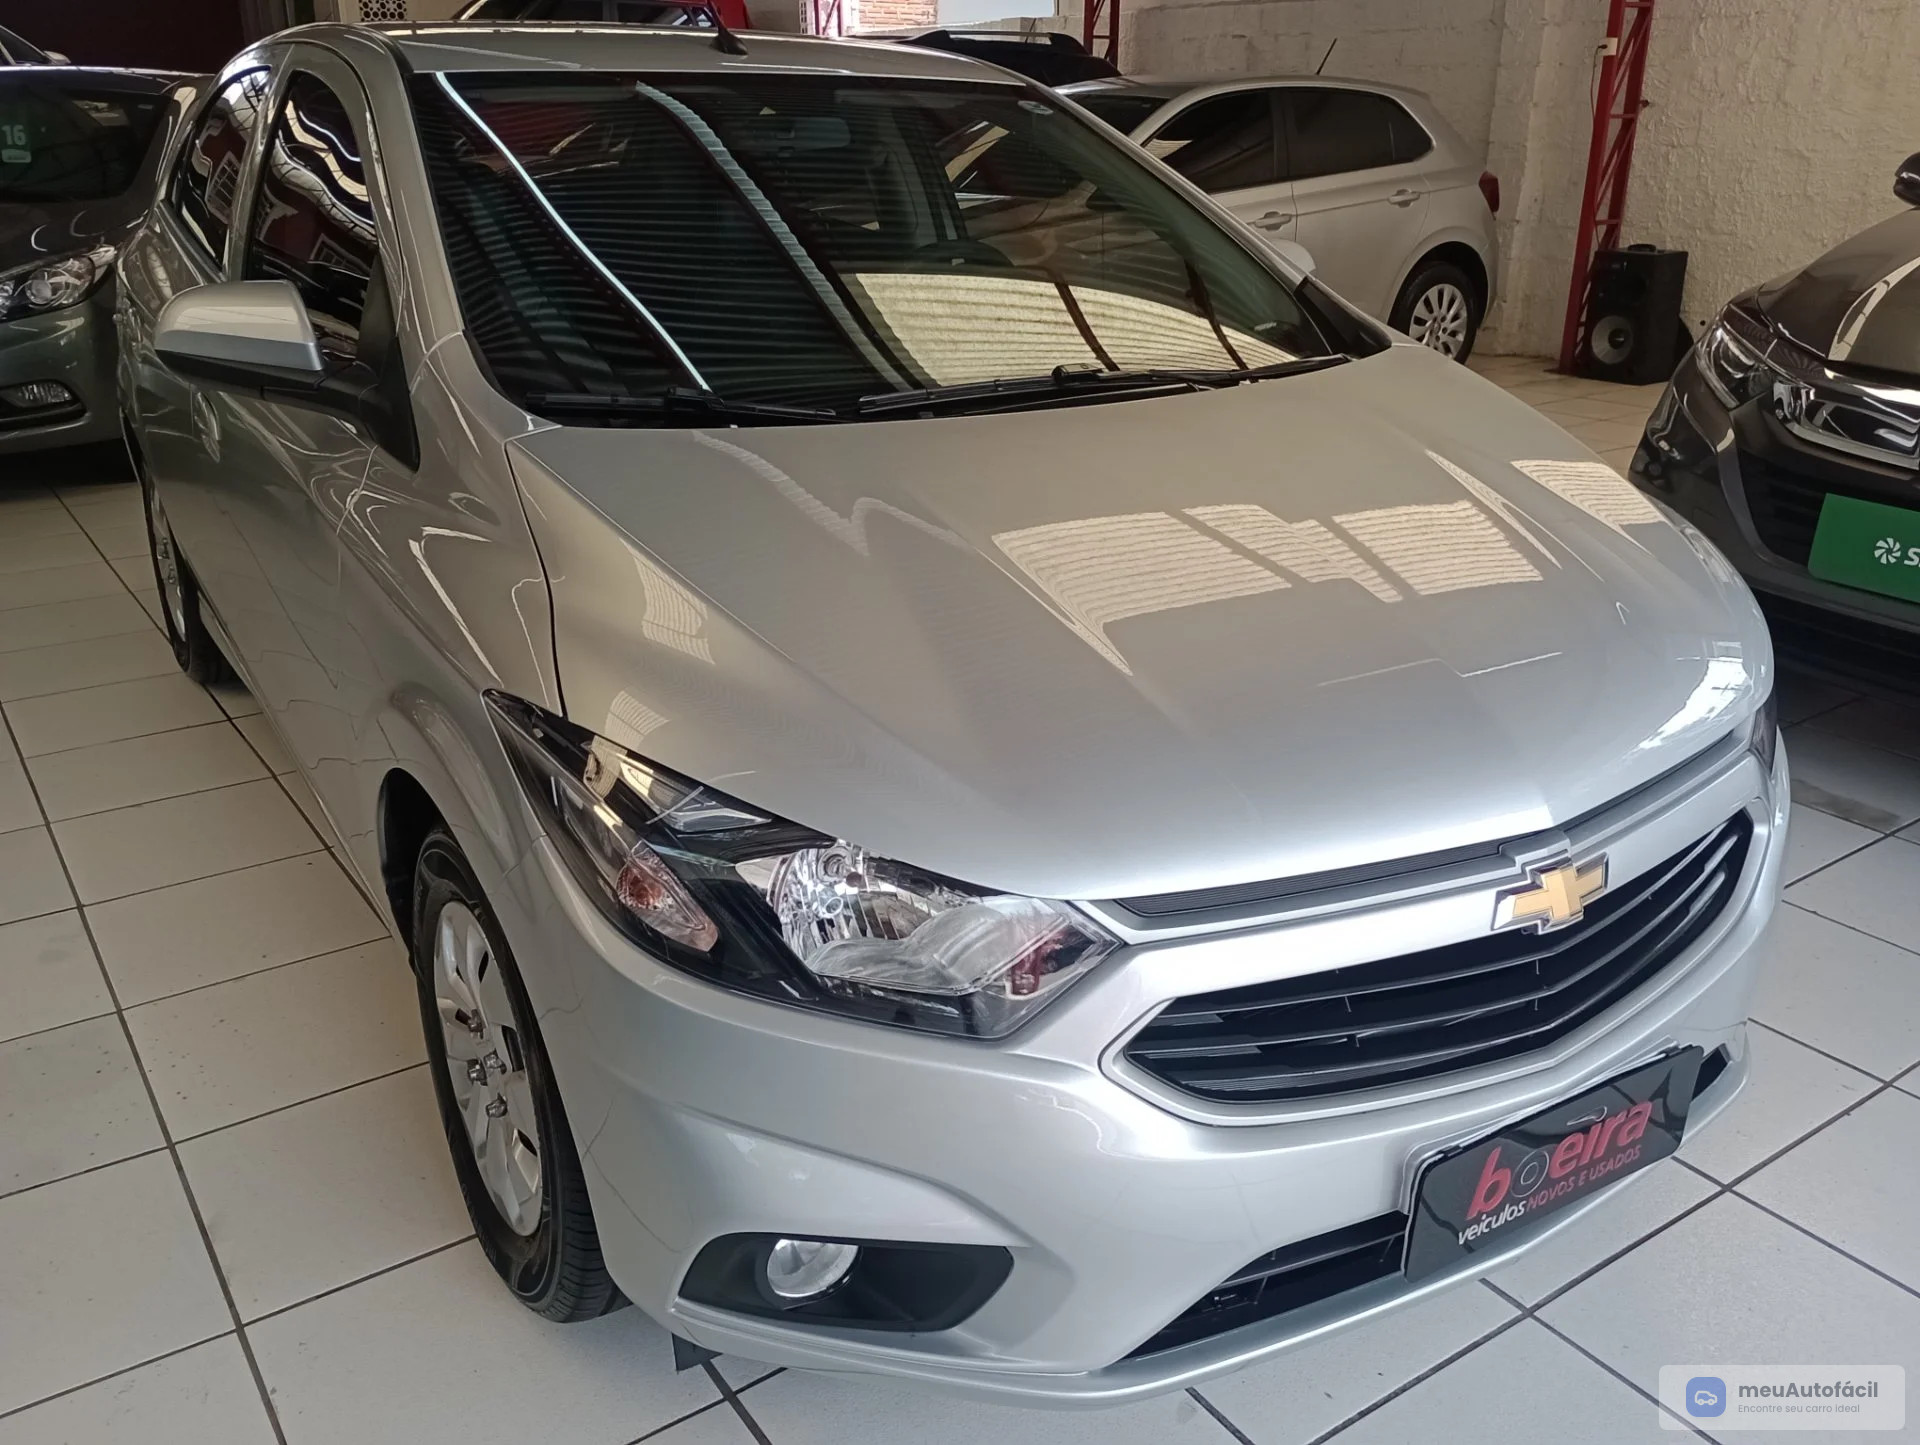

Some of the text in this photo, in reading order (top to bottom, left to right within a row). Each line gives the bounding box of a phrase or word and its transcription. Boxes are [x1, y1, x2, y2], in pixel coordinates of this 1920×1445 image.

[1904, 548, 1920, 567] S
[1465, 1100, 1653, 1221] boeira
[1525, 1176, 1576, 1213] NOVOS
[1578, 1171, 1588, 1187] E
[1589, 1144, 1642, 1181] USADOS
